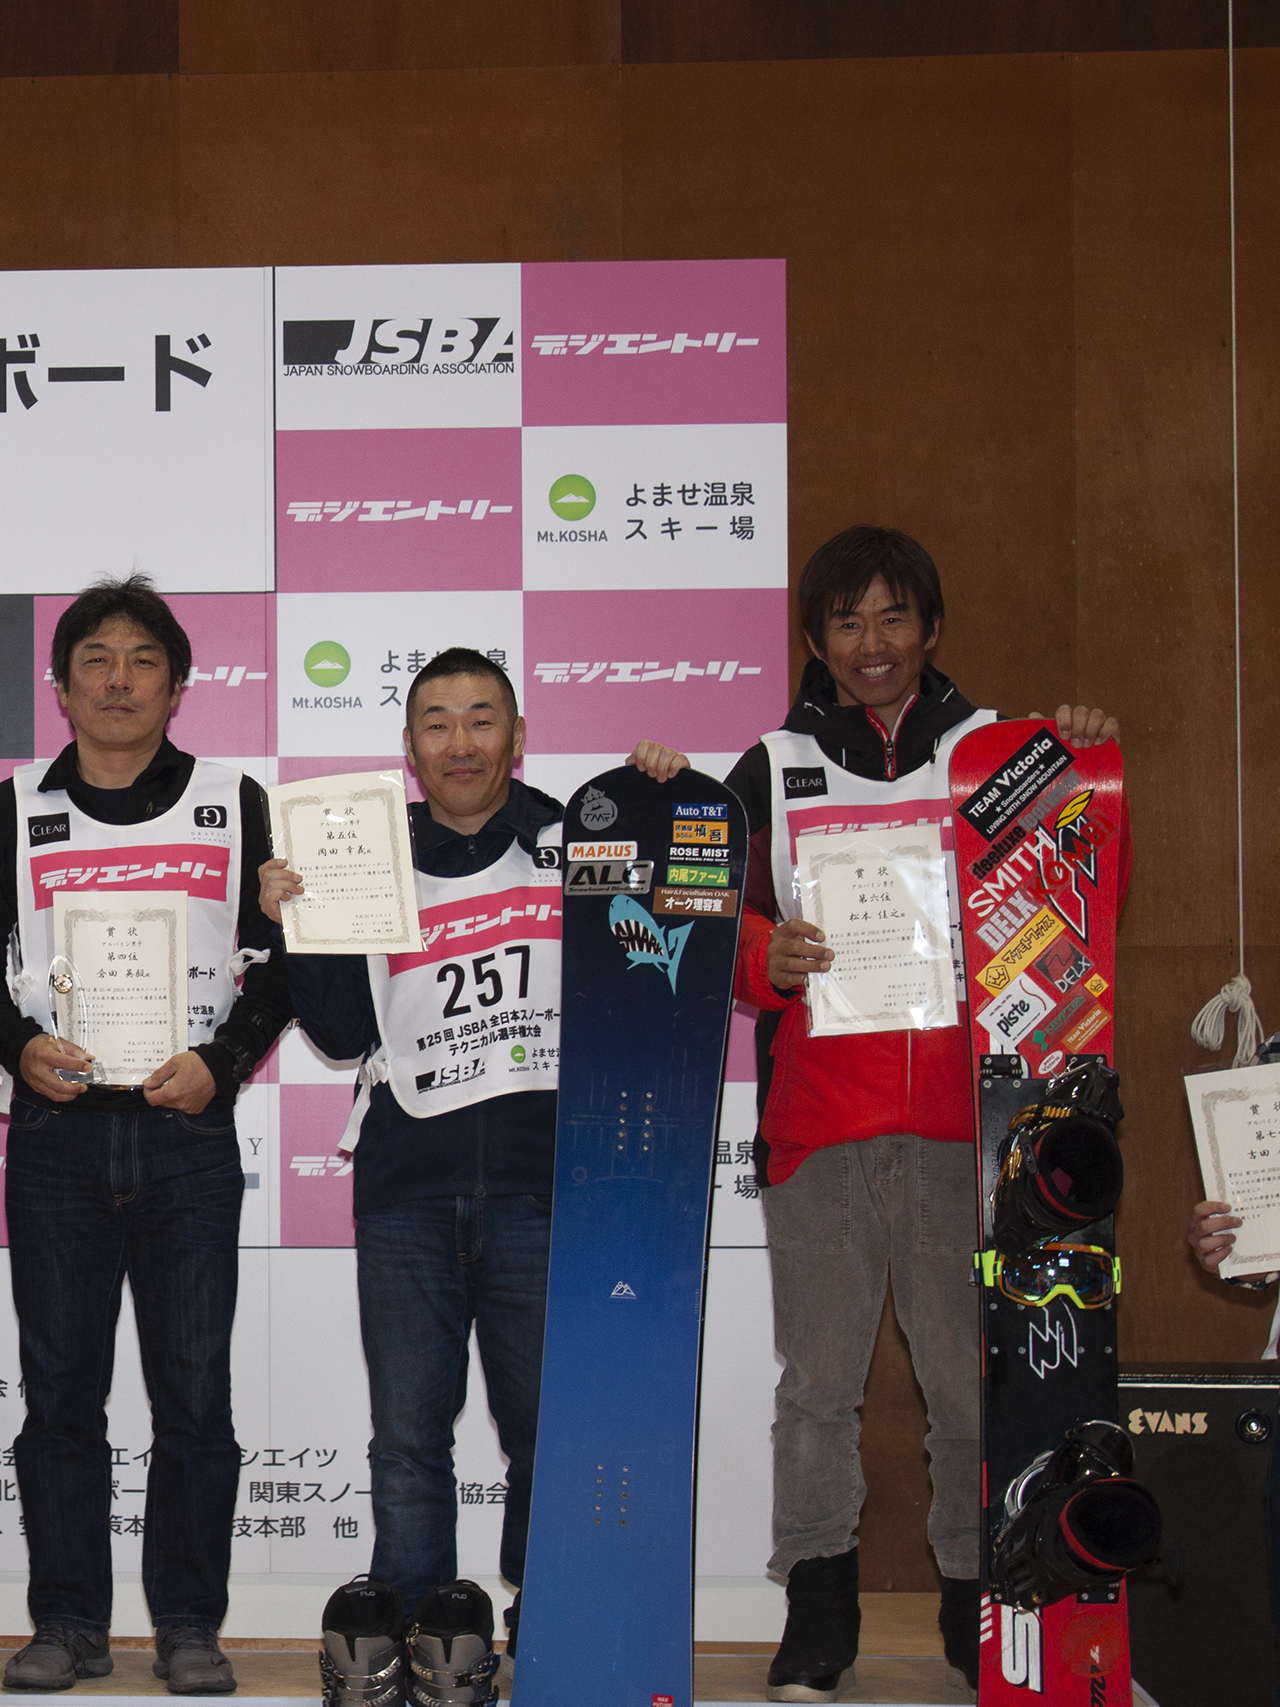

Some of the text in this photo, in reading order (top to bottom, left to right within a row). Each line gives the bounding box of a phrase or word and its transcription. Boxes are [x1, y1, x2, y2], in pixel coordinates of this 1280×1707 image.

[332, 317, 515, 364] JSBA
[531, 332, 760, 356] デジエントリー
[283, 362, 515, 377] JAPAN SNOWBOARDING ASSOCIATION
[625, 481, 756, 507] よませ温泉
[286, 499, 513, 522] デジエントリー
[536, 530, 609, 543] Mt.KOSHA
[625, 515, 756, 542] スキー場
[533, 661, 762, 683] デジエントリー
[292, 696, 363, 709] Mt.KOSHA
[785, 776, 823, 789] CLEAR
[969, 737, 1053, 819] TEAM Victoria
[1001, 768, 1041, 809] Snowboarders
[986, 754, 1068, 835] LIVING WITH SNOW MOUNTAIN
[675, 806, 724, 817] Auto T&T
[31, 823, 67, 837] CLEAR
[326, 830, 358, 841] 第五位
[571, 845, 632, 858] MAPLUS
[669, 847, 730, 858] ROSE MIST
[971, 824, 1027, 881] deeluxe
[1027, 813, 1115, 903] KOMBI
[39, 861, 222, 888] デジエントリー
[569, 864, 649, 885] ALC
[668, 867, 727, 884] 内尾ファーム
[855, 866, 889, 879] 賞状
[967, 829, 1056, 918] SMITH
[665, 896, 723, 912] オーク理容室
[858, 892, 892, 905] 第六位
[420, 904, 562, 945] ジエントリー
[849, 912, 872, 922] 松本
[105, 926, 138, 938] 賞状
[107, 952, 138, 962] 第四位
[436, 944, 531, 1020] 257
[1053, 956, 1092, 994] DELX
[996, 998, 1030, 1038] piste
[1043, 994, 1087, 1035] KRYPTON
[1078, 1008, 1102, 1032] Victoria
[457, 1019, 489, 1038] JSBA
[449, 1024, 542, 1057] テクニカル選手権大会
[1128, 1408, 1209, 1436] EVANS
